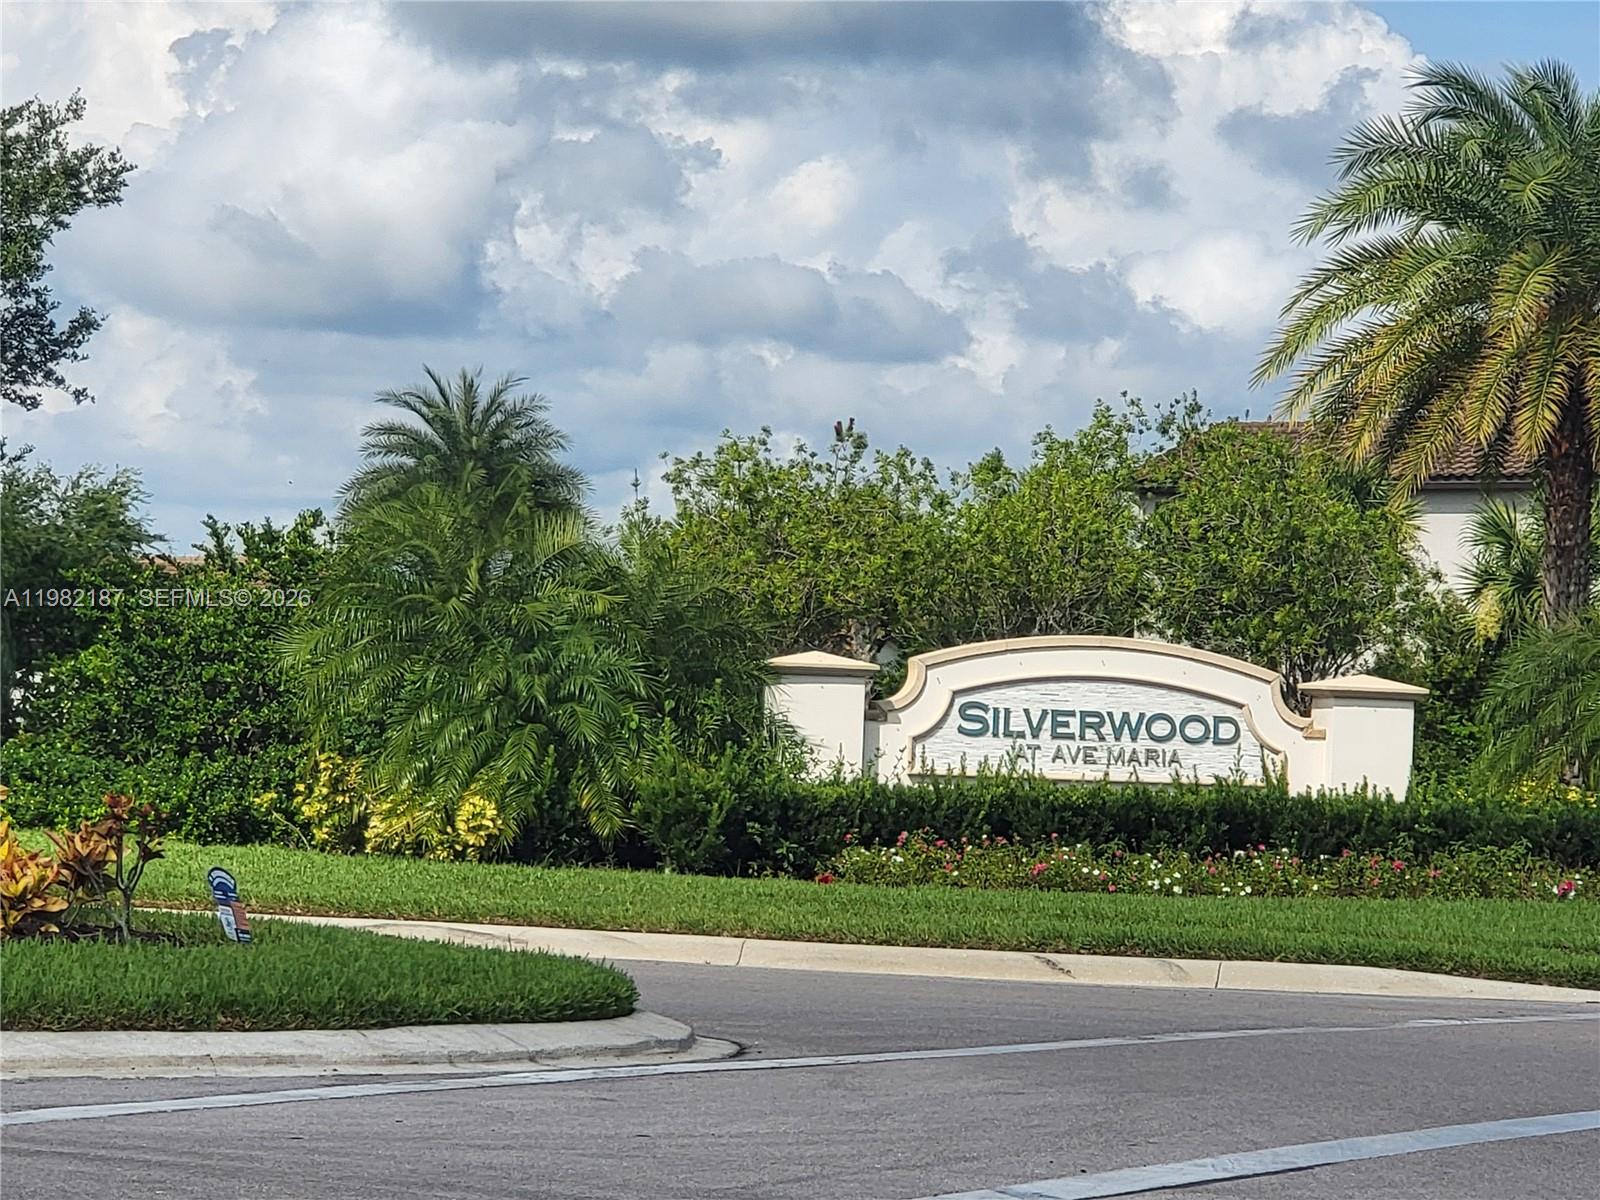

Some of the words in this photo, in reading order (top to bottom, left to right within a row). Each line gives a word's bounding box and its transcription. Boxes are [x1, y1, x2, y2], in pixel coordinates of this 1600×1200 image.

[957, 701, 1241, 746] SILVERWOOD
[1013, 744, 1041, 765] AT
[1051, 744, 1098, 765] AVE
[1106, 747, 1183, 768] MARIA
